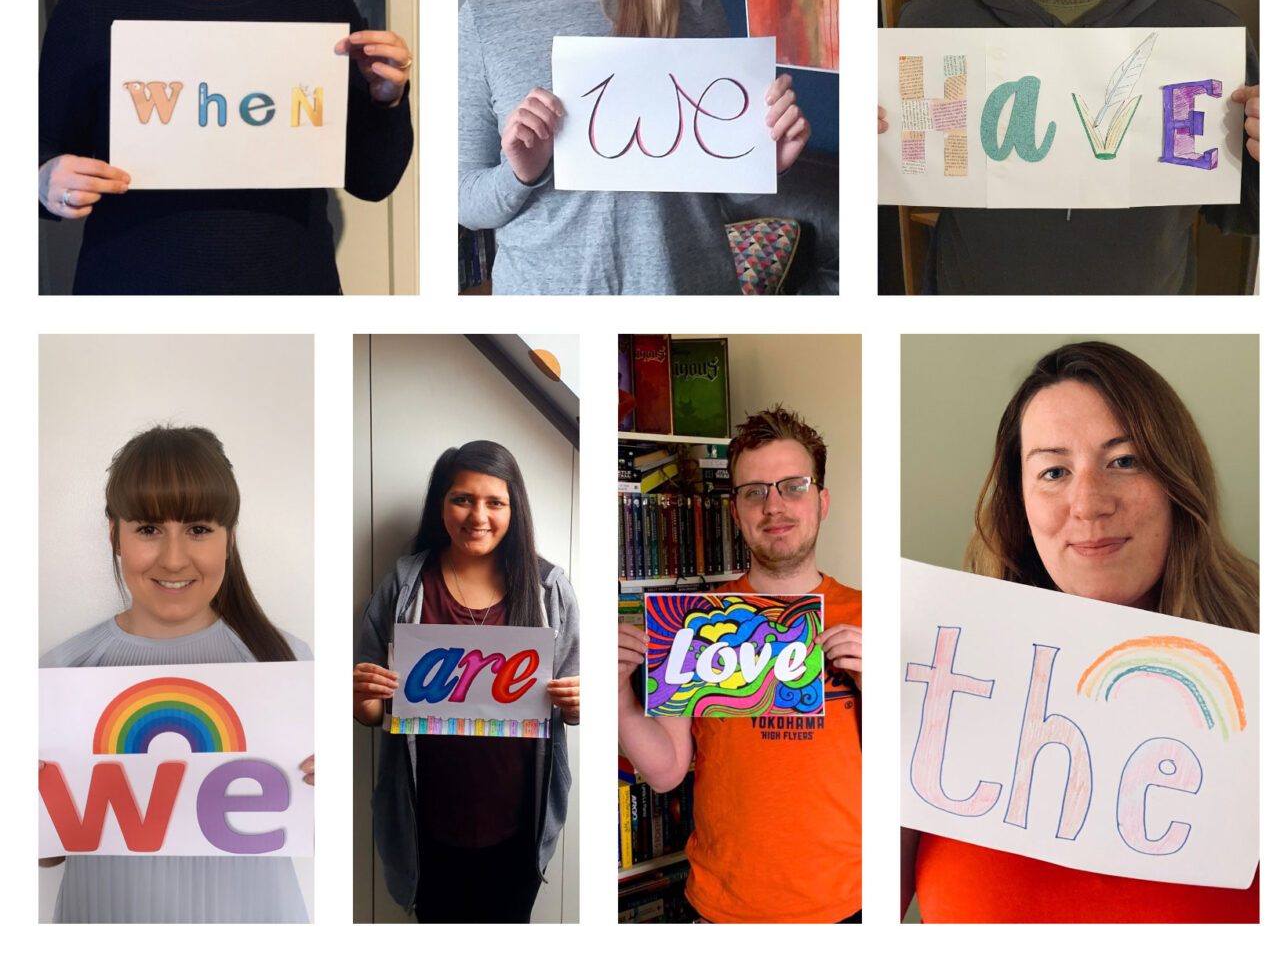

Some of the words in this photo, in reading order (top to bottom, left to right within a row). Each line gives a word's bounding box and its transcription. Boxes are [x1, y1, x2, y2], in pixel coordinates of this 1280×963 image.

[404, 646, 540, 705] are
[665, 628, 808, 686] Love
[751, 716, 825, 730] YOKOHAMA
[904, 625, 1203, 856] the
[38, 758, 291, 855] we
